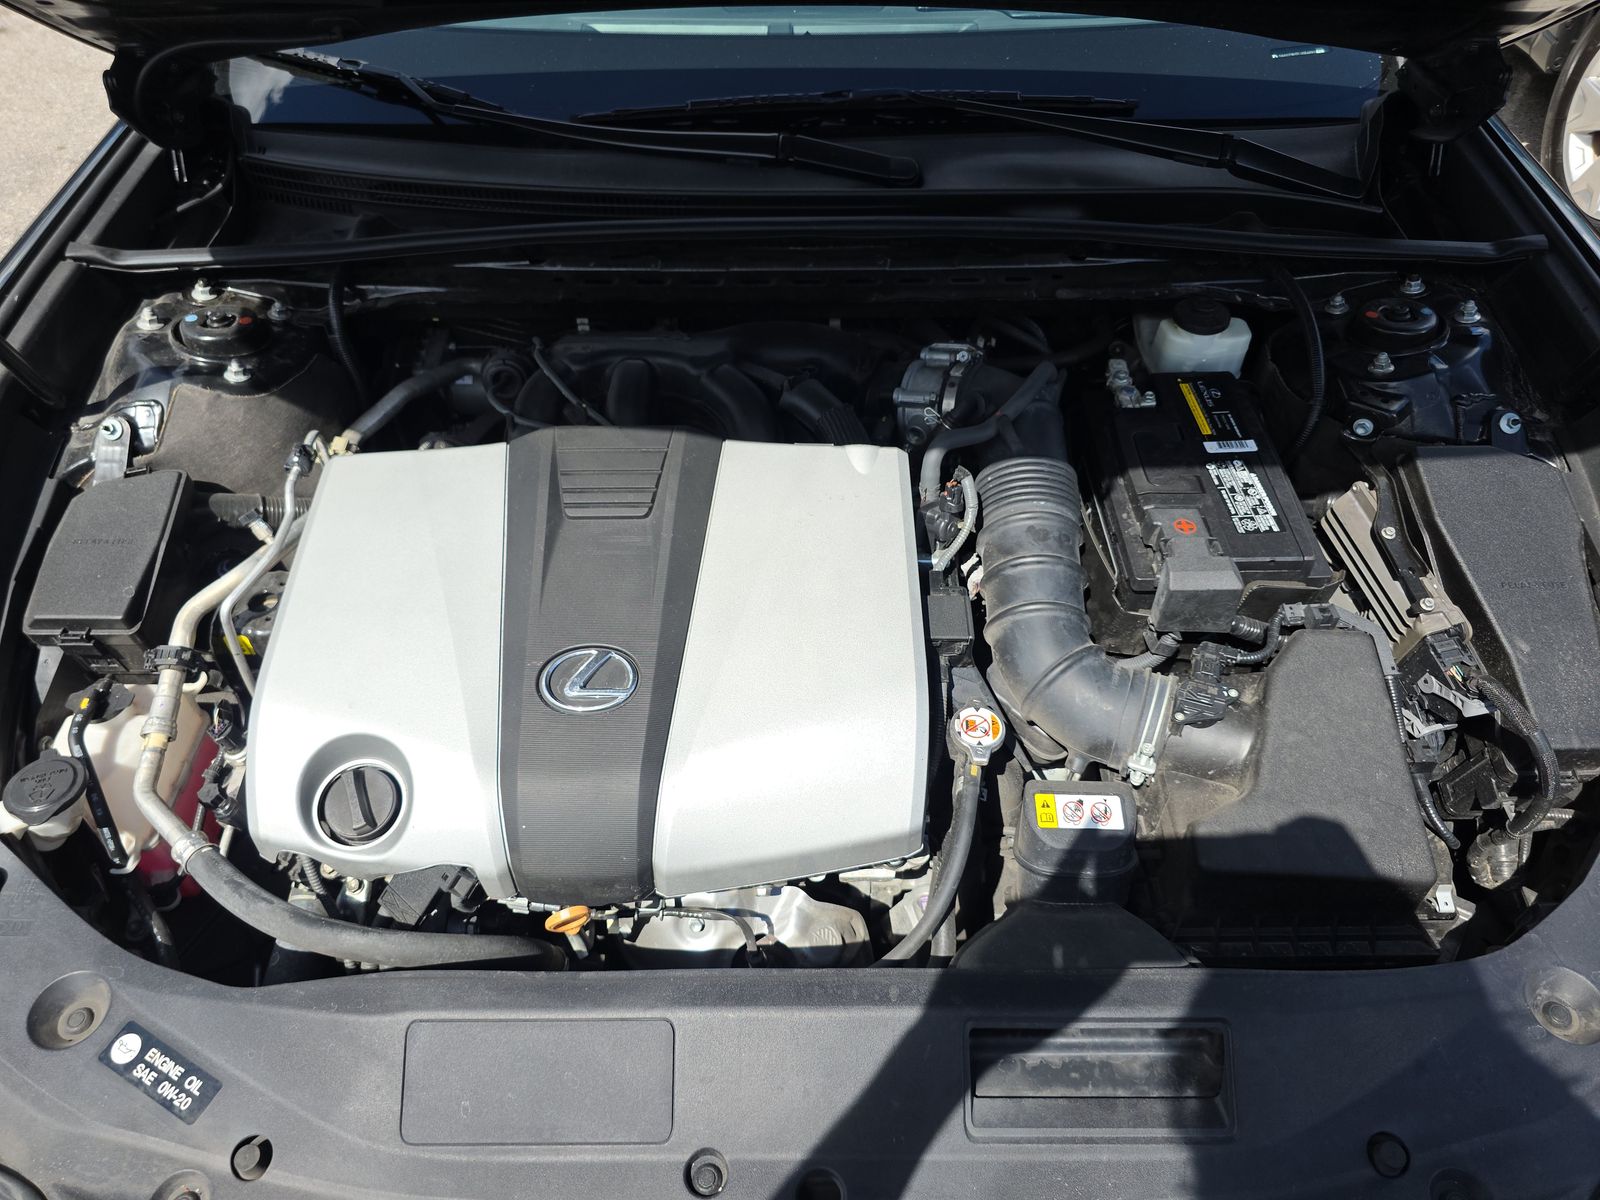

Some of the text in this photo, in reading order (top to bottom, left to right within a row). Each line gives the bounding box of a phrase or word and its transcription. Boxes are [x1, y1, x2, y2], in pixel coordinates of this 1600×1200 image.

[1197, 381, 1214, 407] LEXUS
[132, 1063, 192, 1110] SAE 0W-20
[144, 1047, 203, 1096] ENGINE OIL
